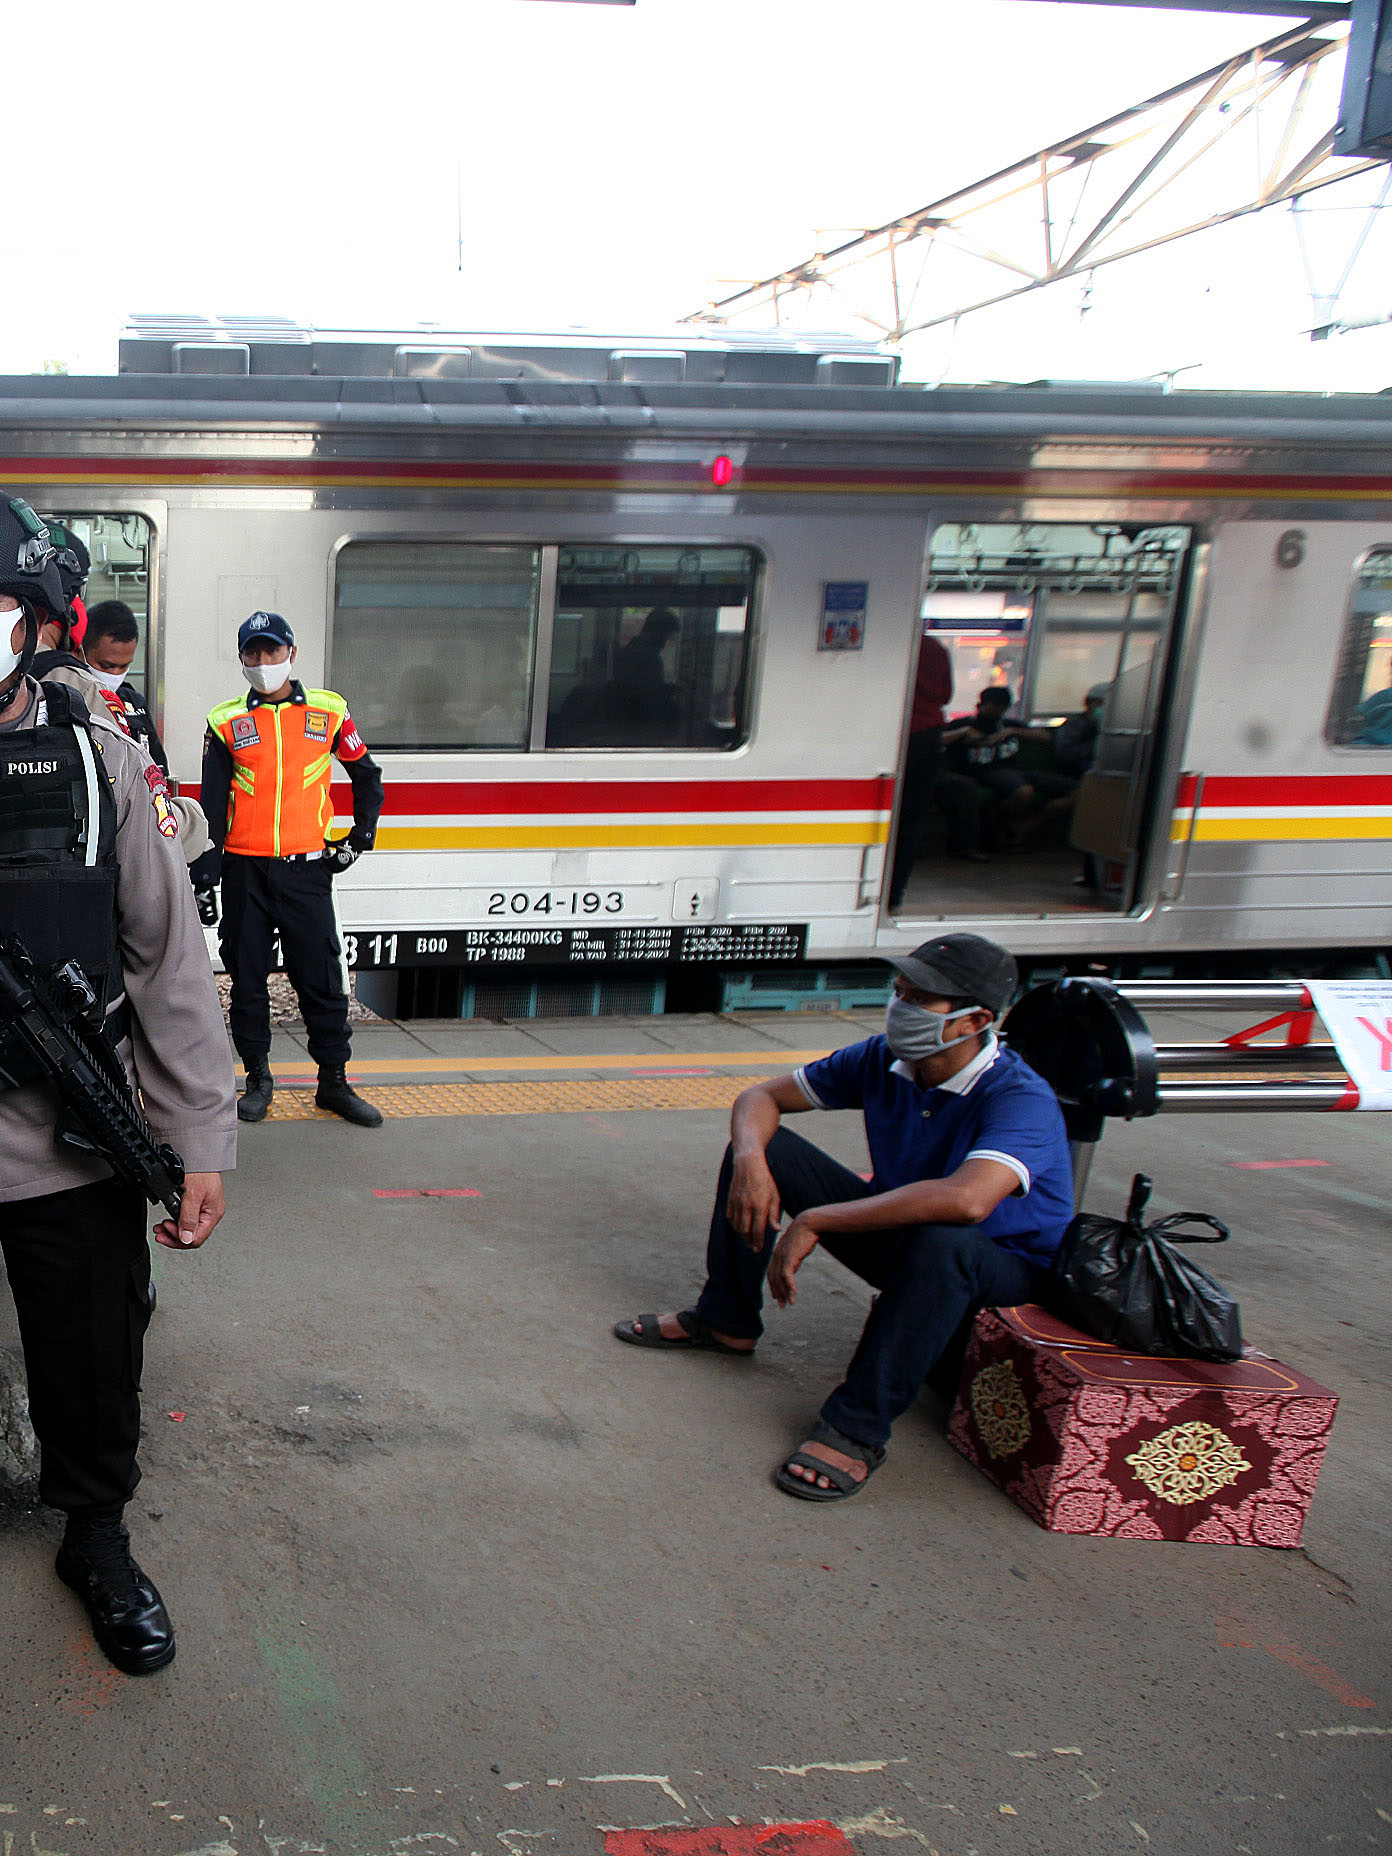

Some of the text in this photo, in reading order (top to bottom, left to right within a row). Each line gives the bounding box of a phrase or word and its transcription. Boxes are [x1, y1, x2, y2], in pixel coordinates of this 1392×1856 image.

[1277, 529, 1305, 569] 6
[7, 761, 58, 775] POLISI
[488, 892, 624, 915] 204-193
[466, 931, 563, 945] BK-34400KG
[368, 934, 398, 965] 11
[466, 947, 526, 961] TP 1988
